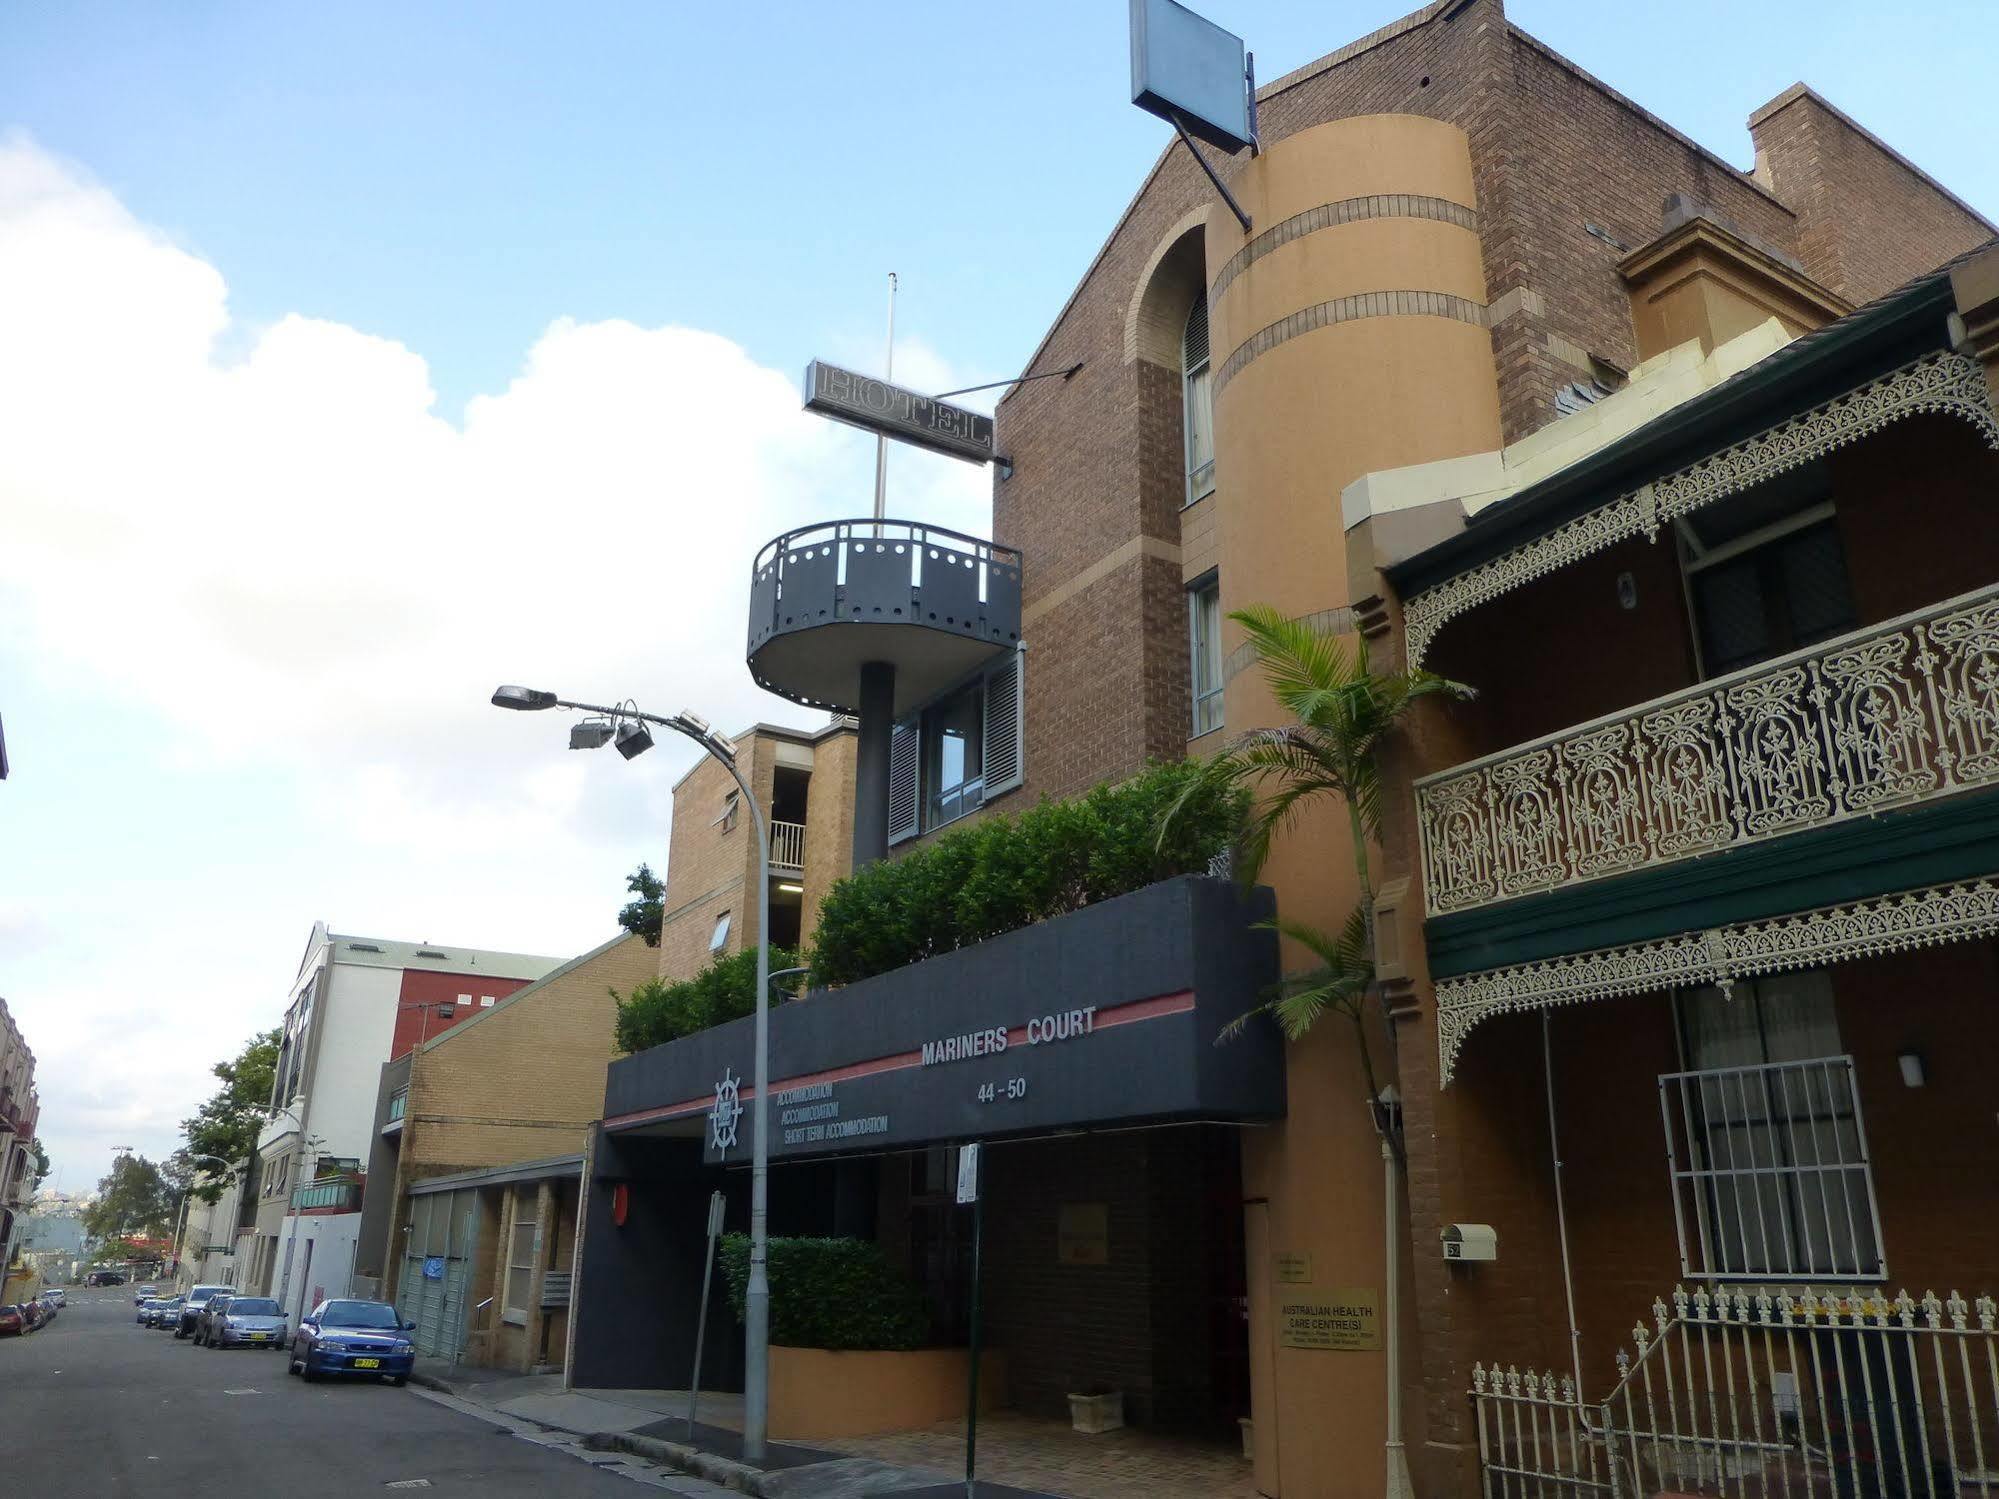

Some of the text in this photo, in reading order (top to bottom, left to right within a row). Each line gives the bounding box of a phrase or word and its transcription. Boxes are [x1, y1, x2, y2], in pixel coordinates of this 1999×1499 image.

[817, 364, 991, 448] HOTEL
[921, 1006, 1097, 1066] MARINERS COURT
[807, 1125, 825, 1142] TERM
[826, 1115, 888, 1140] ACCOMMODATION
[1282, 1306, 1373, 1317] AUSTRALIAN HEALTH
[1290, 1318, 1362, 1331] CARE CENTRE(S)
